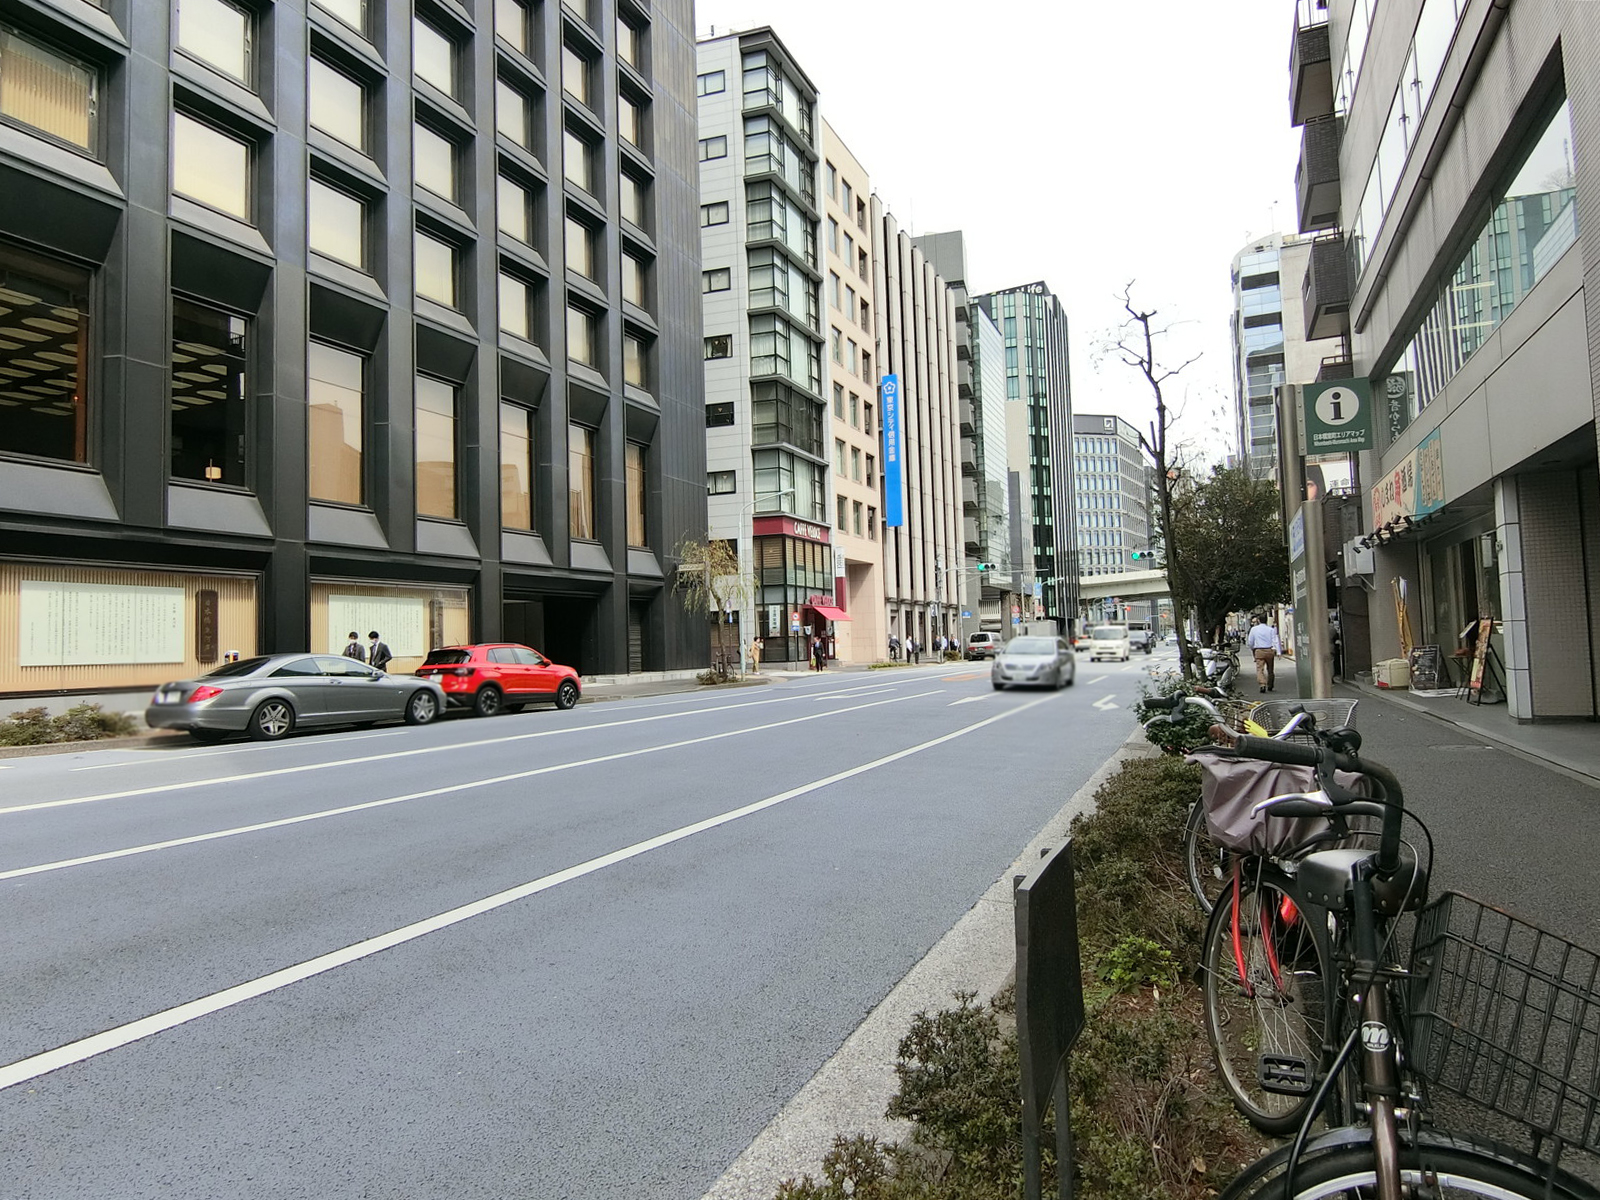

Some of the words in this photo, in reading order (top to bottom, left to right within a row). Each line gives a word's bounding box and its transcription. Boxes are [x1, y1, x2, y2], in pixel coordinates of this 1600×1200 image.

[886, 396, 896, 462] 東京シティ信用金庫
